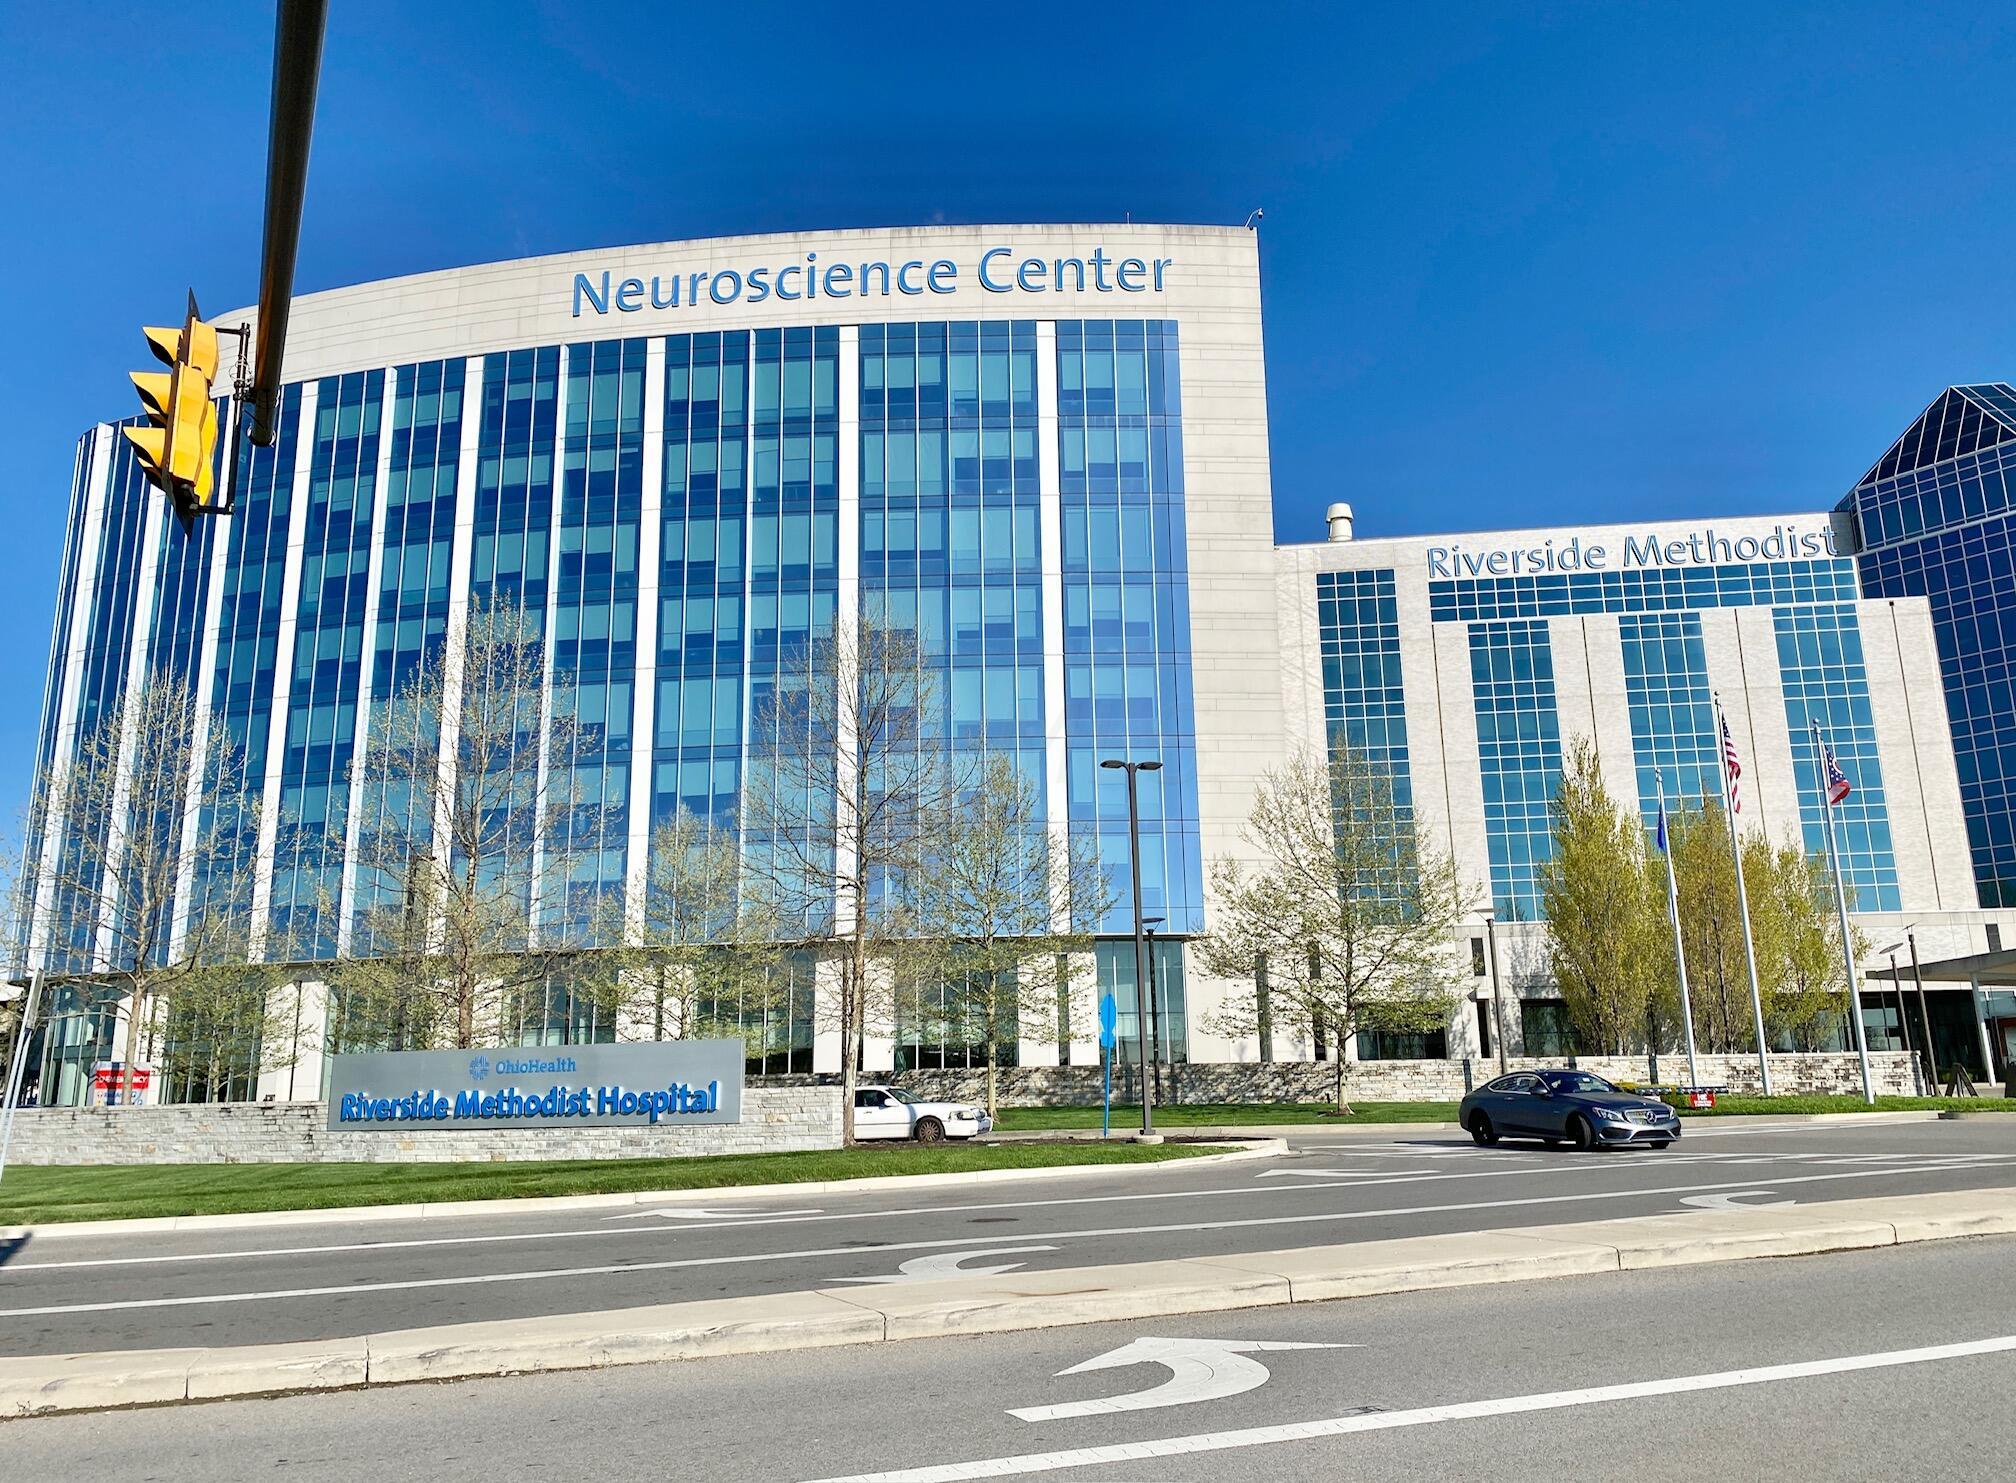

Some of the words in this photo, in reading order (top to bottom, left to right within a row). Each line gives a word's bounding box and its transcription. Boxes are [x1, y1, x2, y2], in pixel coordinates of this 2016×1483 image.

[572, 253, 958, 317] Neuroscience
[977, 247, 1172, 293] Center
[1427, 537, 1607, 579] Riverside
[1623, 525, 1839, 568] Methodist
[496, 1058, 577, 1075] OhioHealth
[340, 1089, 450, 1122] Riverside
[453, 1084, 594, 1120] Methodist
[598, 1080, 720, 1124] Hospital
